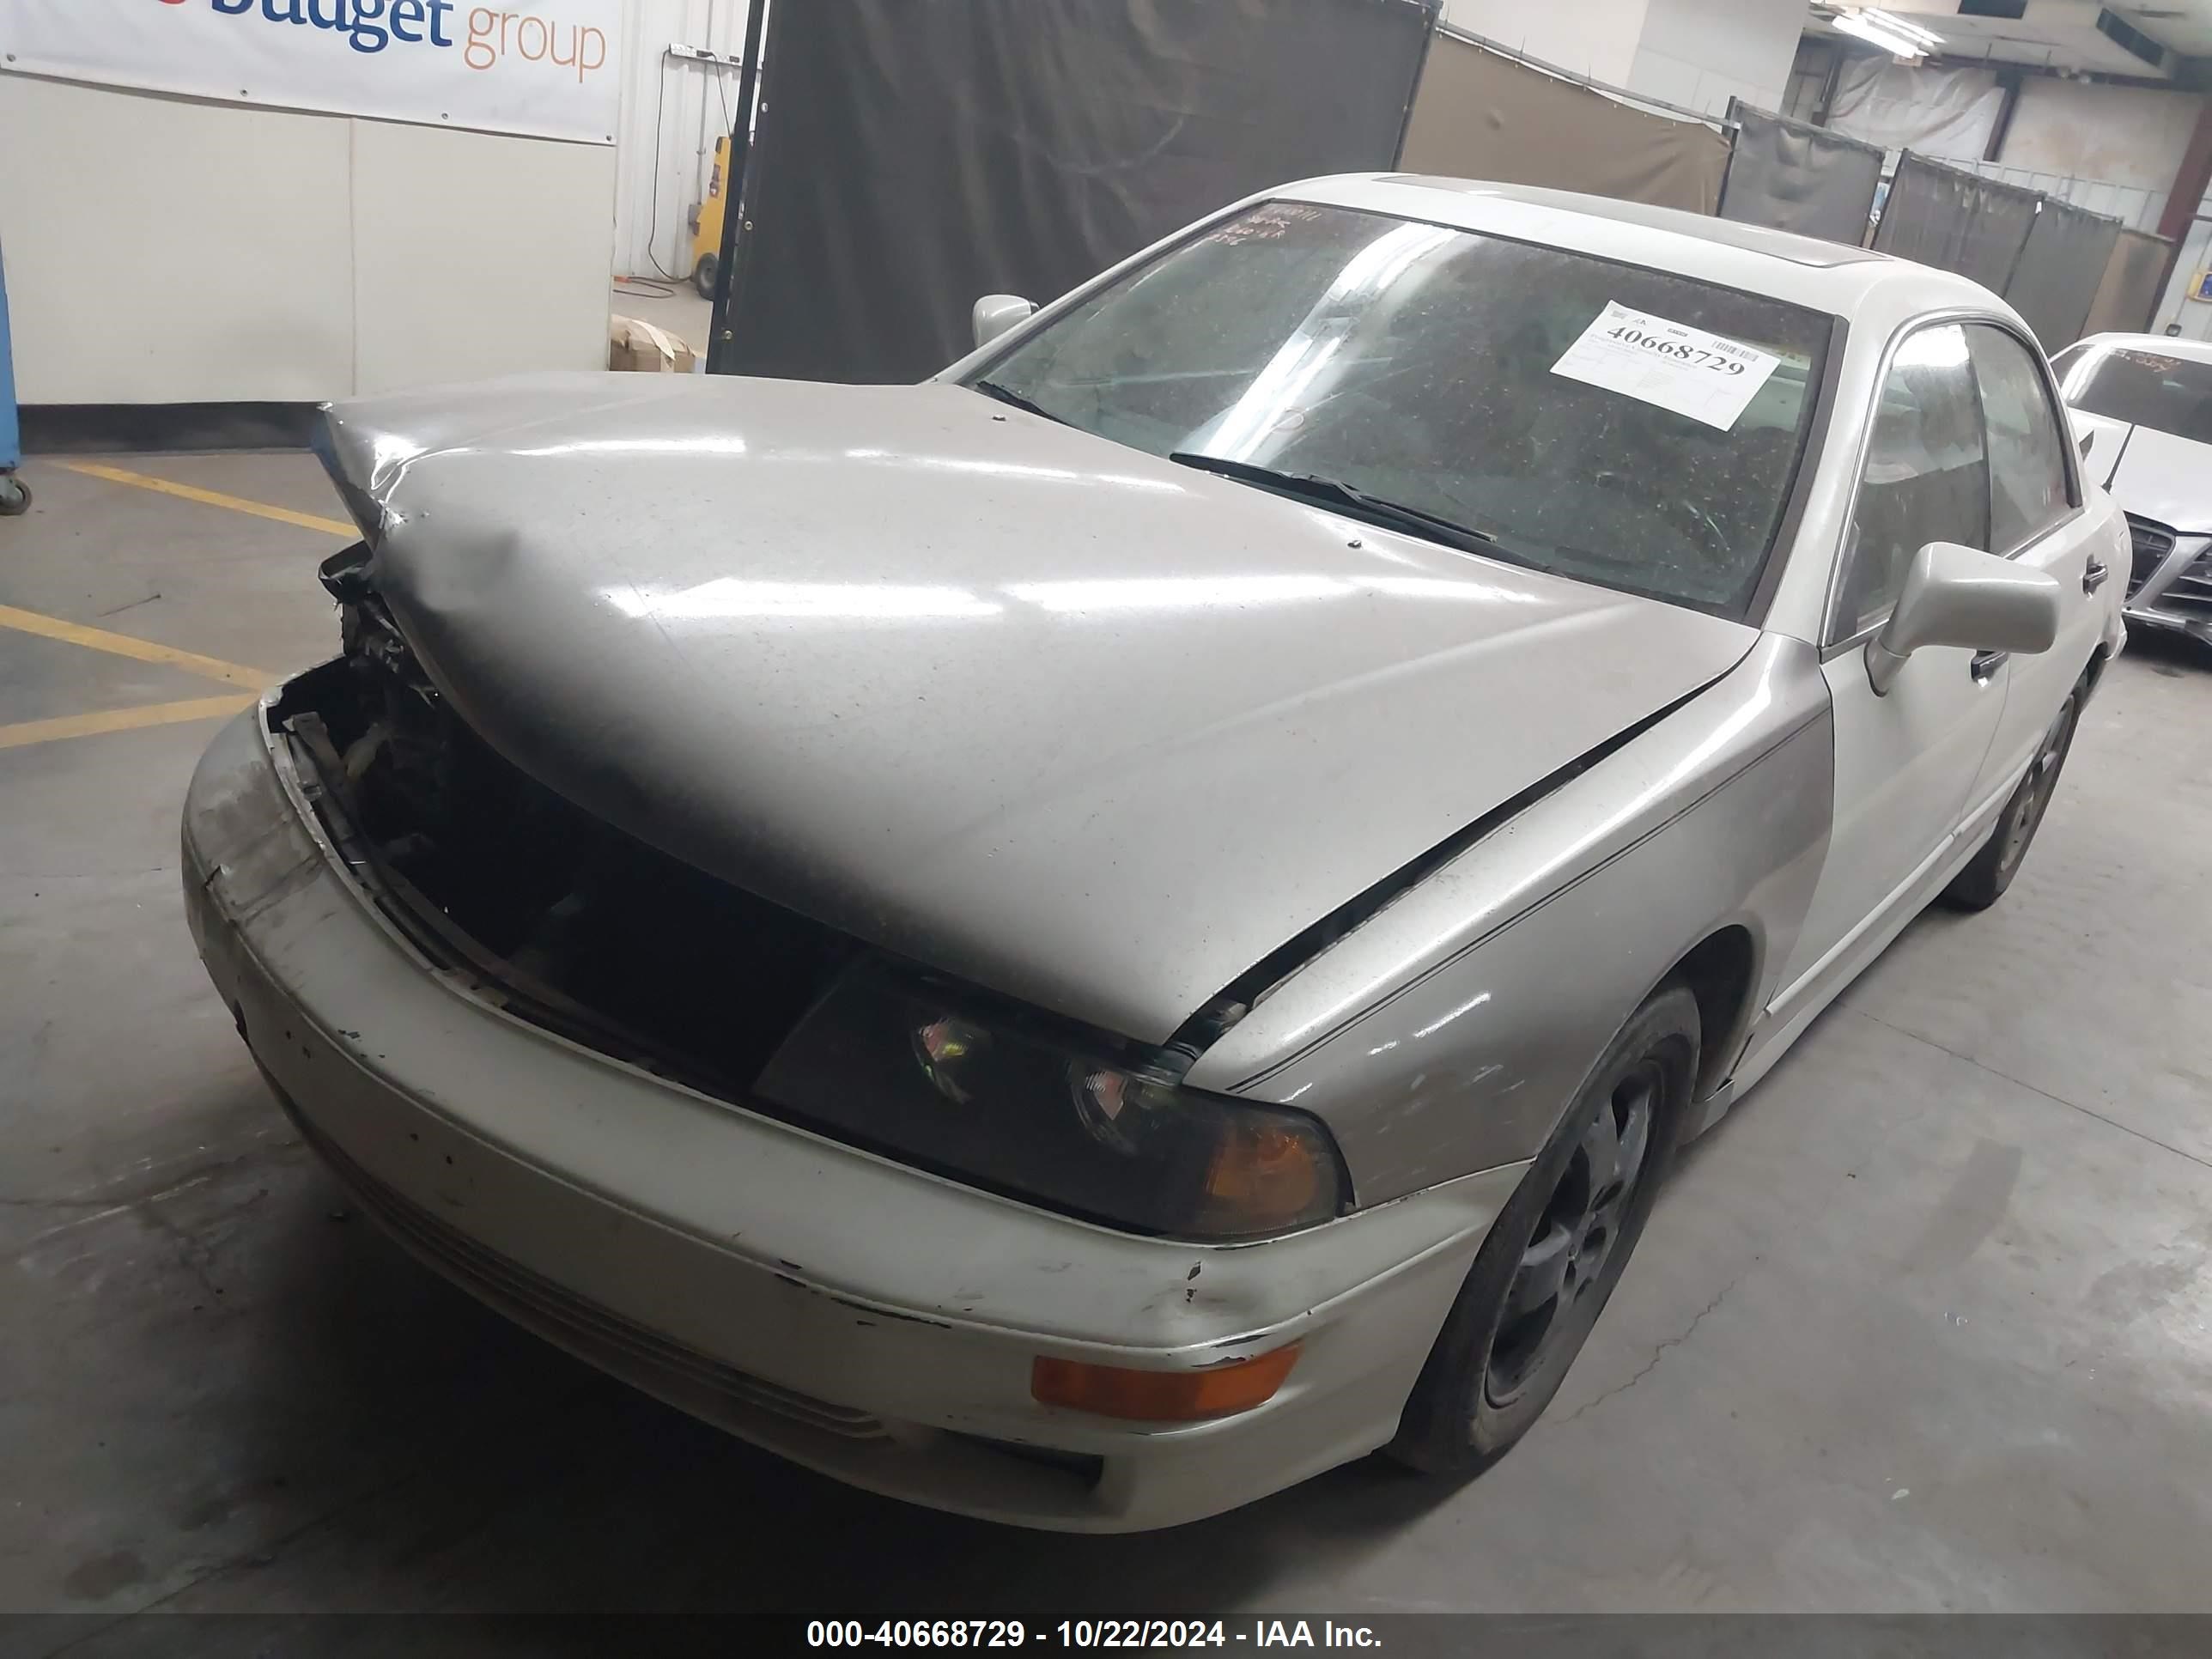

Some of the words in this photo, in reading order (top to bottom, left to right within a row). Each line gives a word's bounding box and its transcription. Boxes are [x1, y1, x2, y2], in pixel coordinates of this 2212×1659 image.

[211, 0, 453, 53] udget
[463, 7, 606, 83] group
[1607, 326, 1746, 375] 40668729
